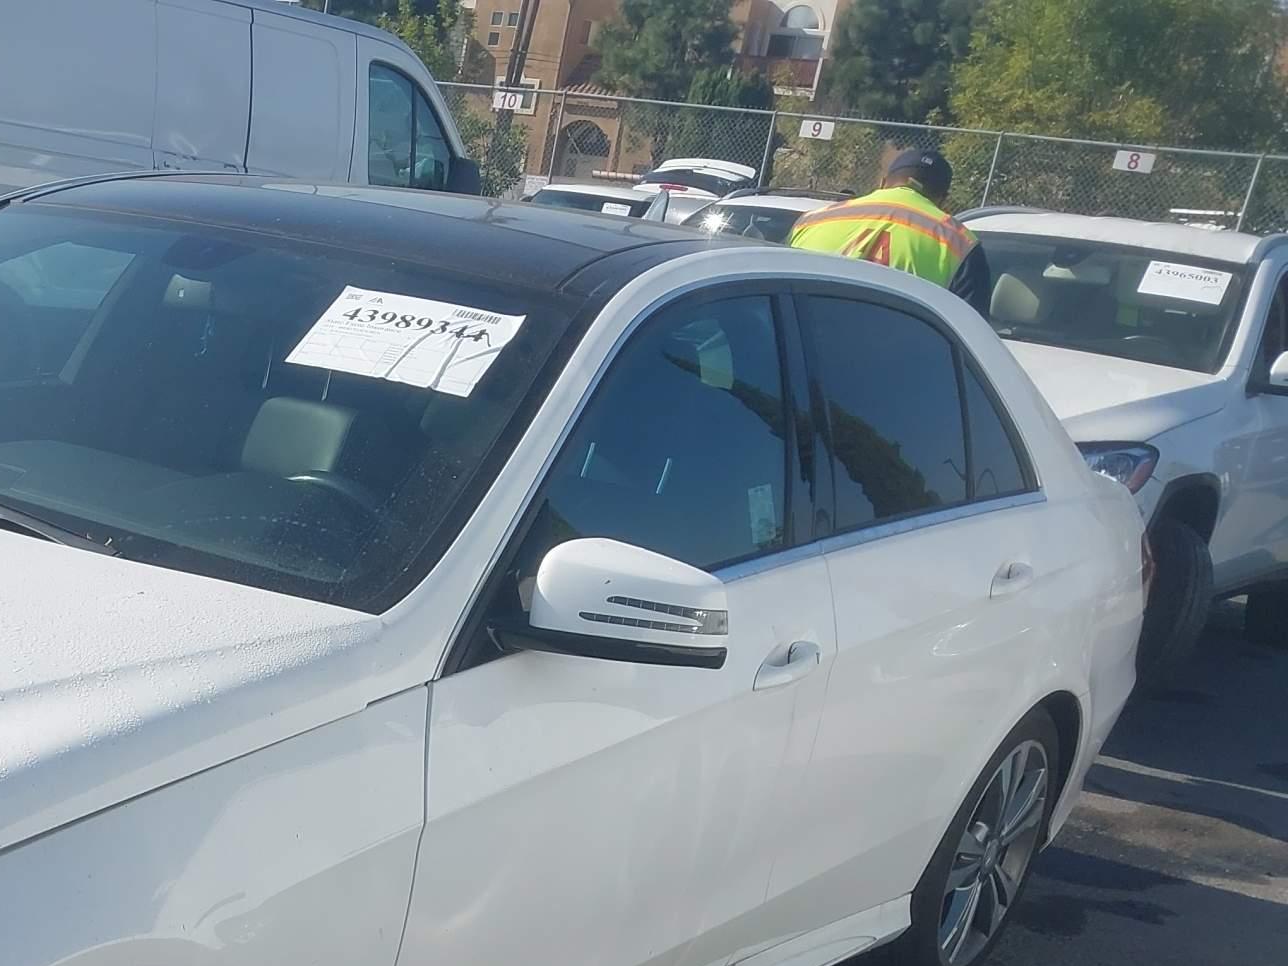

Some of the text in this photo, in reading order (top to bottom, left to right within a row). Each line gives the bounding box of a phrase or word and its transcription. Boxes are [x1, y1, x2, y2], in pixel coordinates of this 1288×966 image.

[501, 92, 517, 108] 10
[812, 122, 822, 137] 9
[1128, 153, 1140, 170] 8
[342, 306, 490, 343] 43989344
